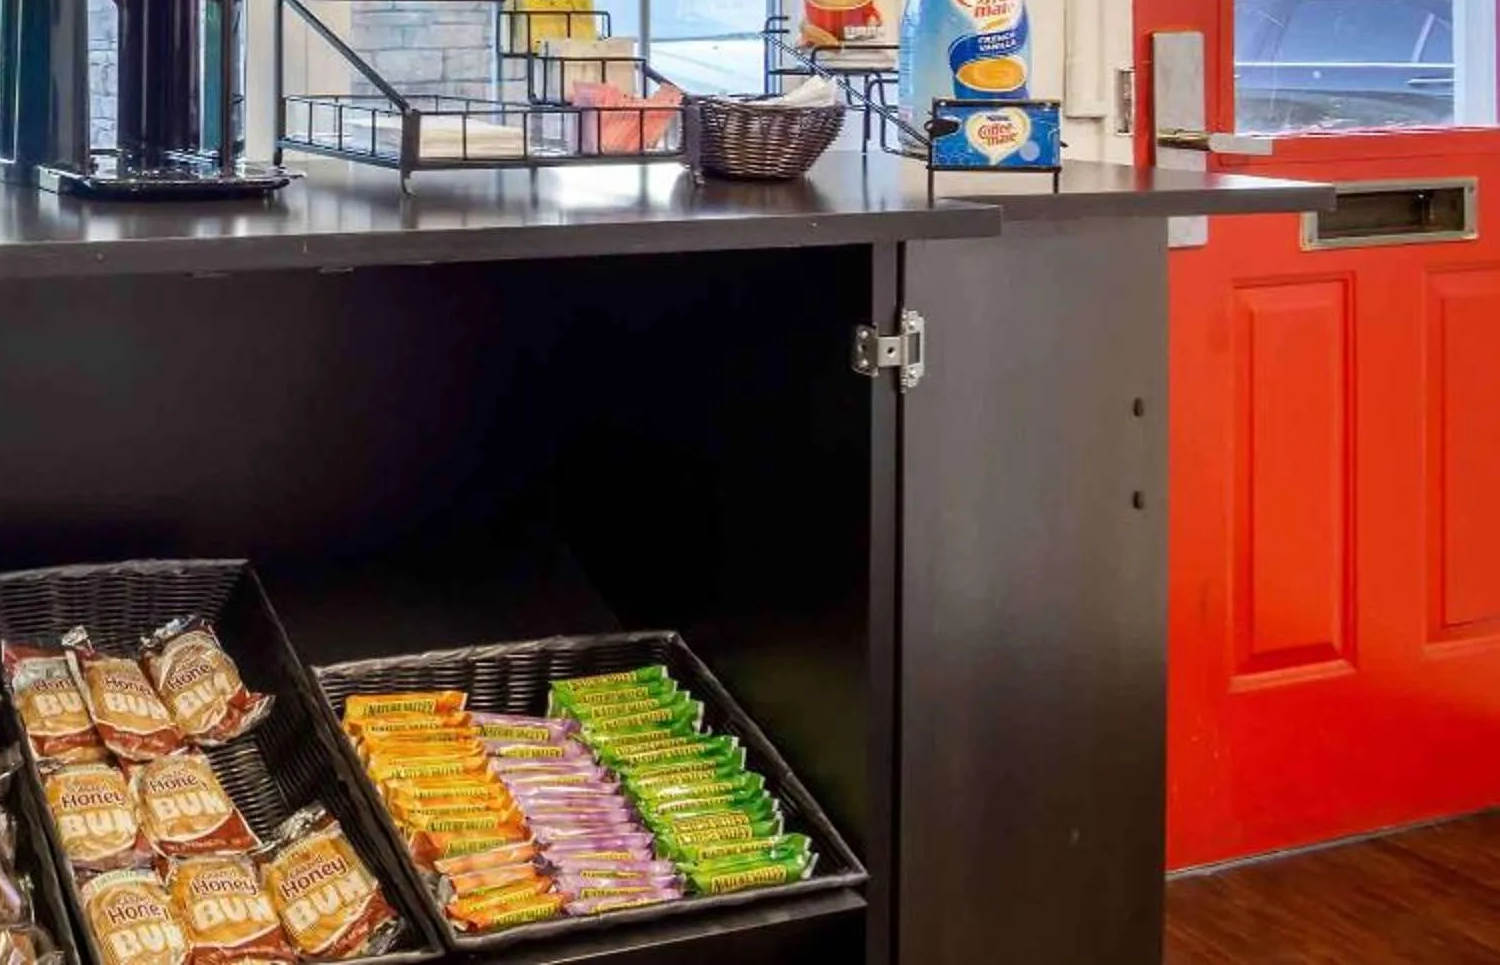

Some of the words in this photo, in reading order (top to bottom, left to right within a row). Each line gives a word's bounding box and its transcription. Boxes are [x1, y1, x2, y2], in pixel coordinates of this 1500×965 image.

[34, 691, 84, 718] BU
[190, 878, 259, 897] Honey
[281, 856, 349, 900] Honey
[193, 896, 278, 933] BUN
[285, 870, 377, 932] BUN
